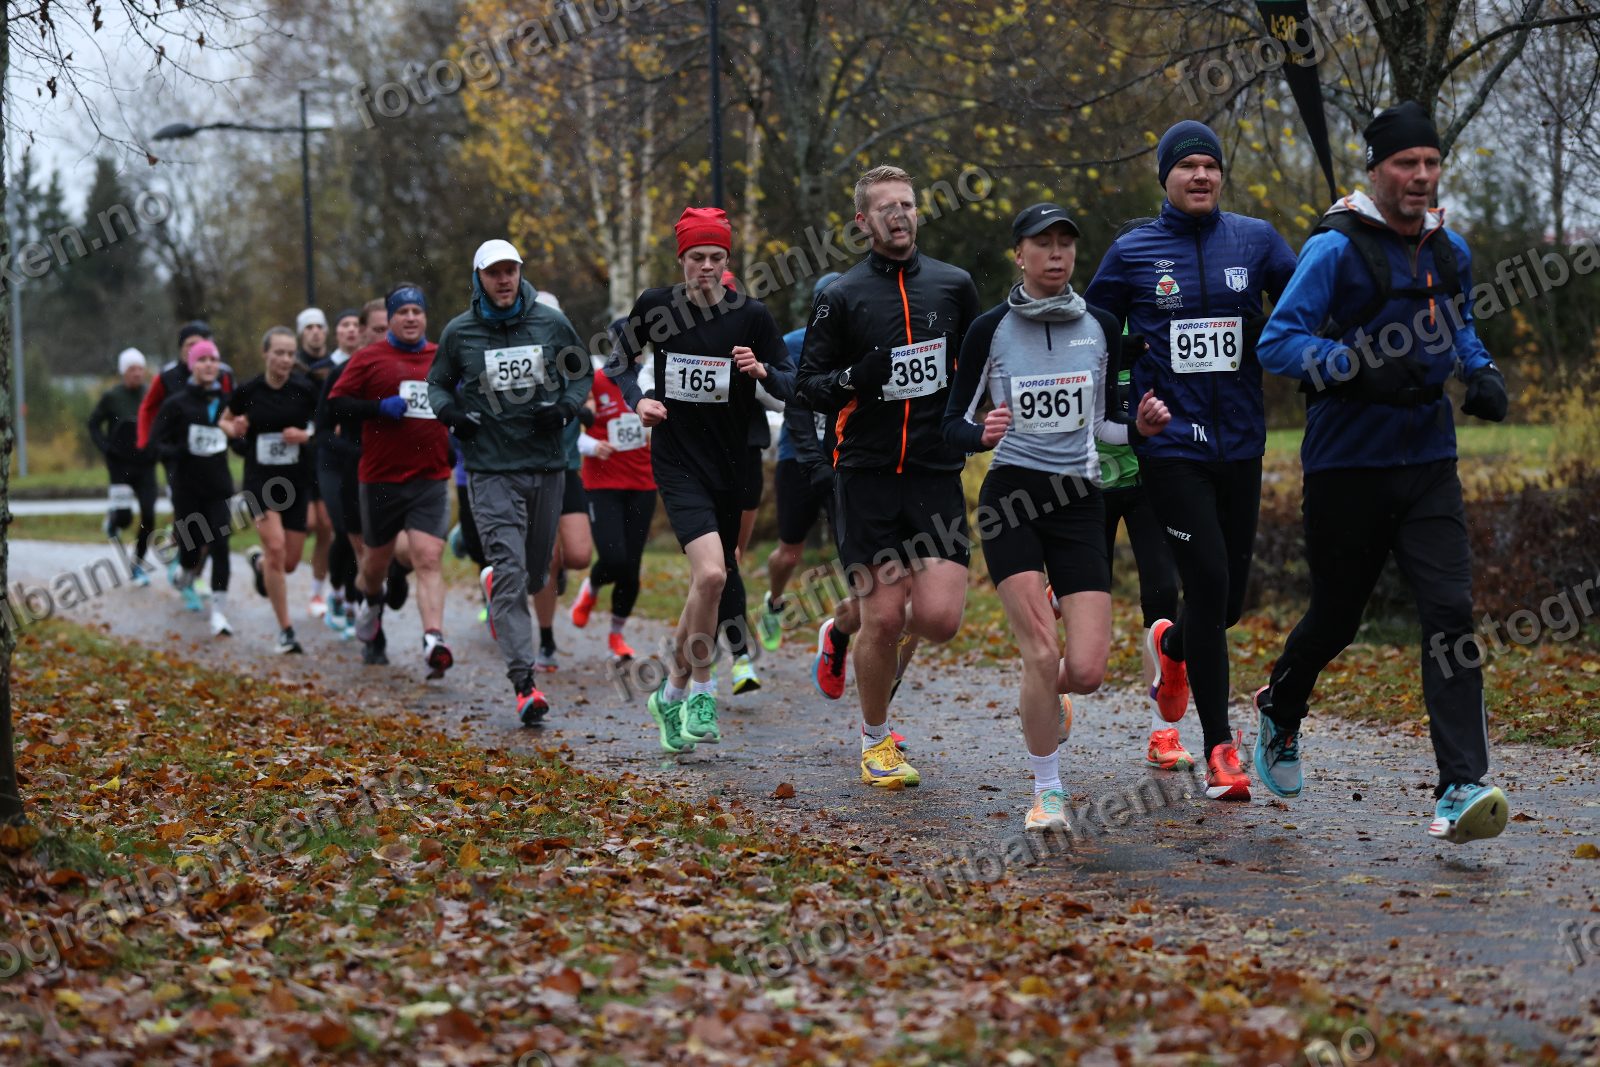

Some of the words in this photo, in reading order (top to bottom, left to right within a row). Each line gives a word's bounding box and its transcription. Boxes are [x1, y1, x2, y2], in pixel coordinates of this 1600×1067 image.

[1176, 321, 1238, 331] NORGESTESTEN
[891, 342, 943, 359] ORGESTESTEN
[1177, 331, 1237, 360] 9518
[498, 358, 534, 381] 562
[672, 356, 727, 367] NORGESTESTEN
[893, 355, 938, 387] 385
[678, 367, 717, 393] 165
[1019, 375, 1087, 388] NORGESTESTEN
[1020, 387, 1083, 419] 9361
[617, 426, 642, 443] 664
[1191, 423, 1208, 442] TK
